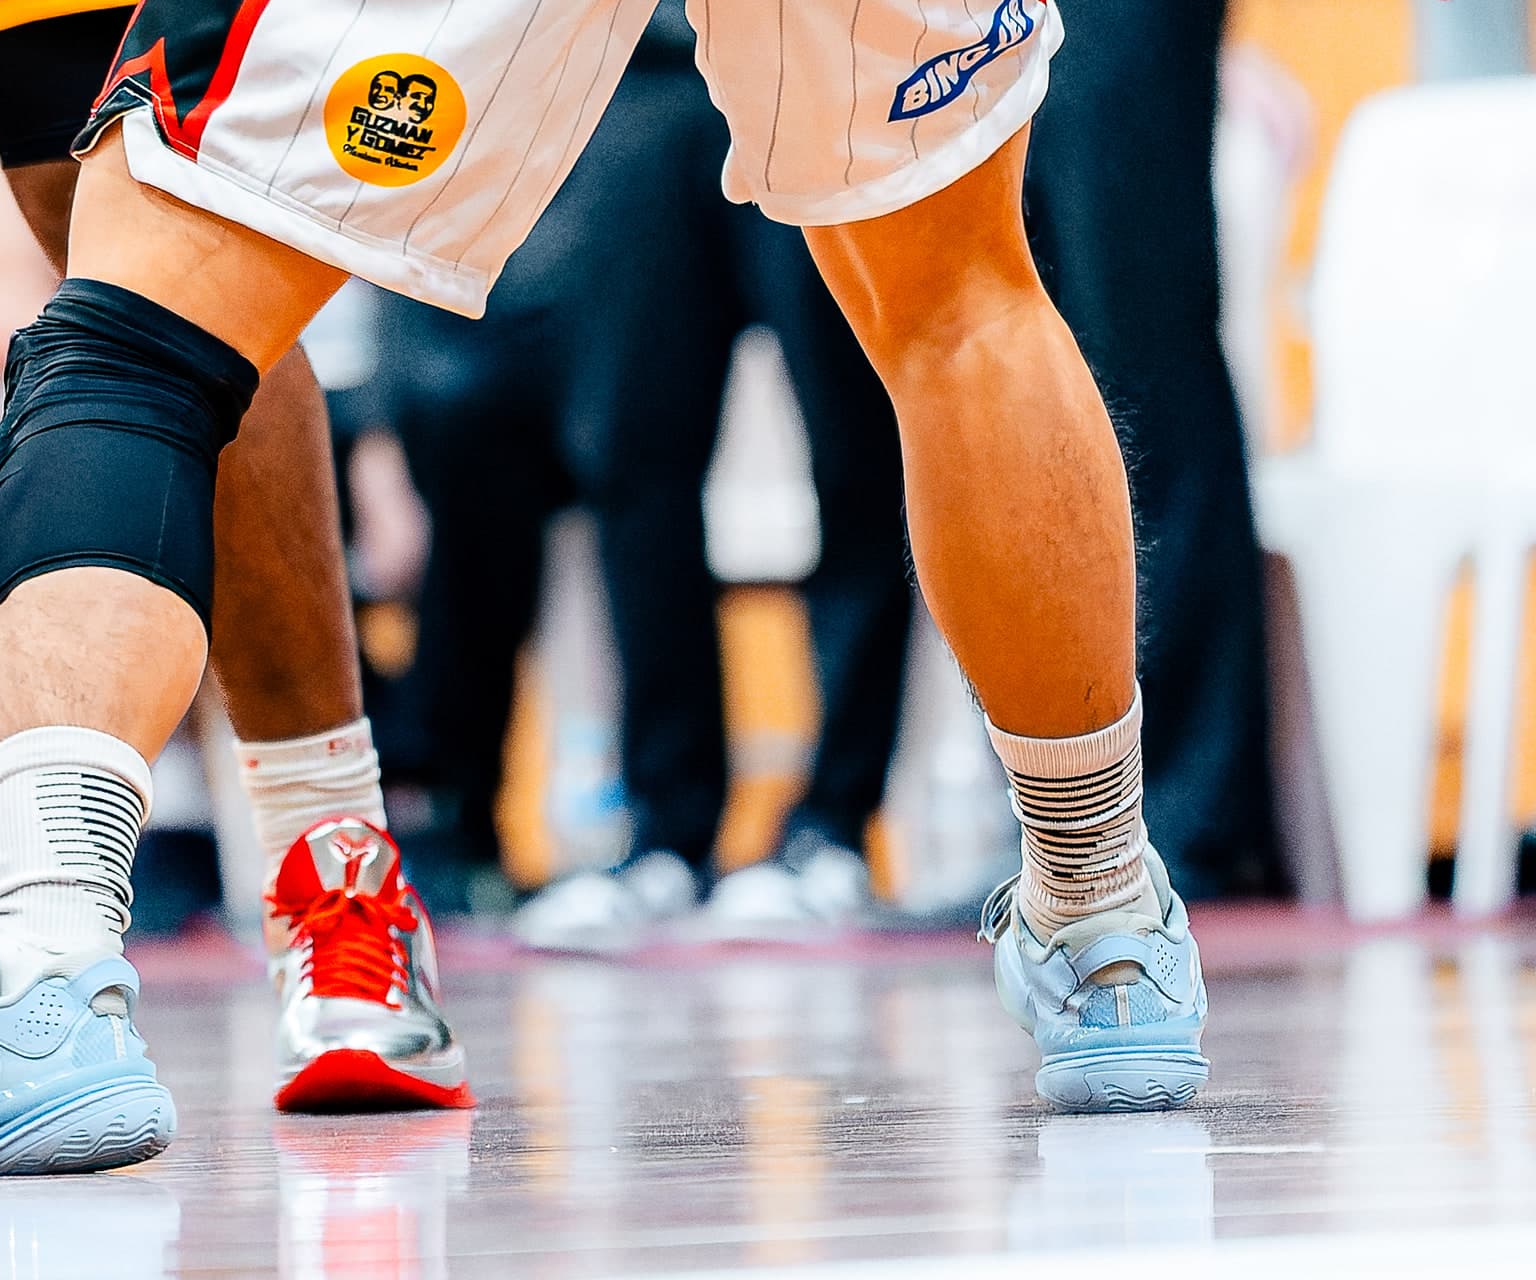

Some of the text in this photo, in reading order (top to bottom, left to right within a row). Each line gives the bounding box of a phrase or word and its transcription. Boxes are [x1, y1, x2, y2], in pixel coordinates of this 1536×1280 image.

[347, 125, 437, 160] Y GOMEZ
[350, 106, 433, 144] GUZMAN
